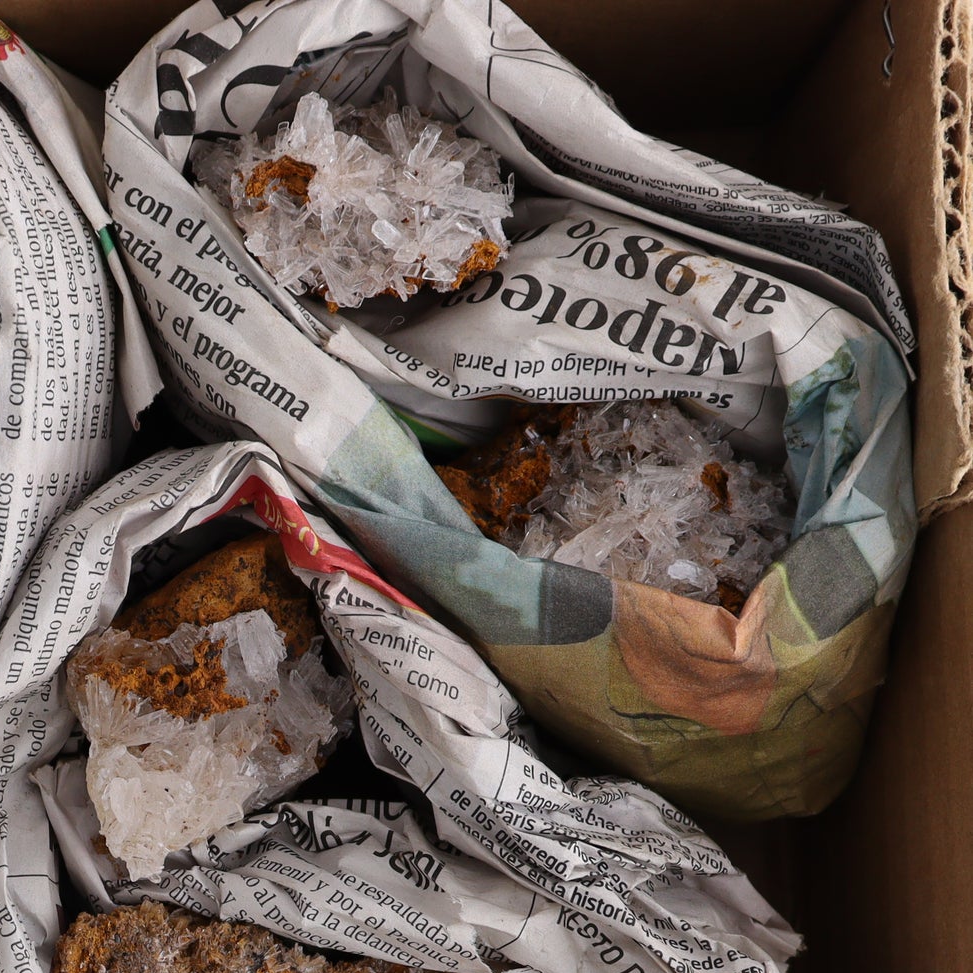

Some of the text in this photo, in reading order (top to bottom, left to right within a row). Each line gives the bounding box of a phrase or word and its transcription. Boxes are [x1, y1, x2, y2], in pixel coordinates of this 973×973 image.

[125, 188, 207, 244] con el
[555, 220, 703, 296] 98%
[167, 265, 245, 325] mejor
[713, 271, 786, 337] al
[1, 303, 35, 439] de compartir
[166, 309, 199, 342] el
[193, 333, 309, 422] programa
[453, 353, 626, 378] Hidalgo del Parral
[90, 489, 140, 515] hacer
[87, 562, 108, 600] es la
[360, 627, 435, 661] Jennifer
[6, 662, 23, 683] un
[407, 670, 459, 700] como
[6, 708, 22, 725] se
[520, 762, 537, 779] el
[450, 790, 470, 810] de
[312, 880, 329, 892] y
[326, 890, 363, 917] por
[365, 917, 385, 930] el
[355, 882, 448, 946] respaldada
[570, 886, 638, 926] historia
[322, 912, 424, 968] la delantera
